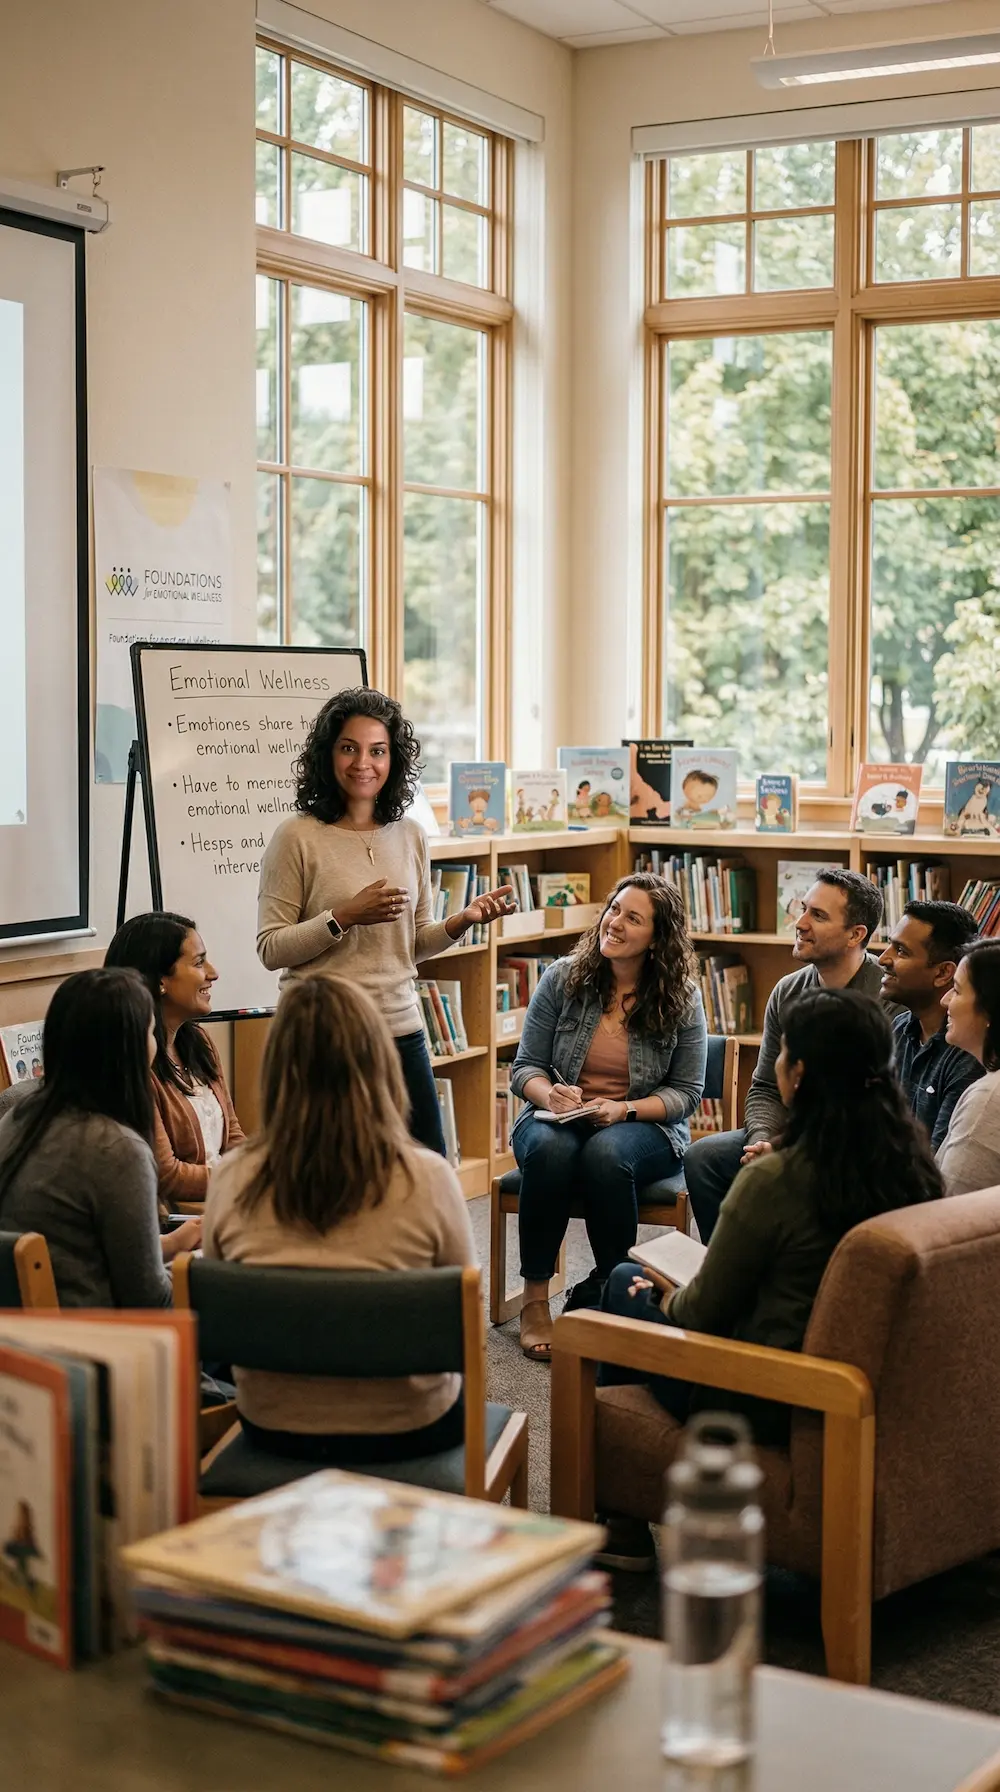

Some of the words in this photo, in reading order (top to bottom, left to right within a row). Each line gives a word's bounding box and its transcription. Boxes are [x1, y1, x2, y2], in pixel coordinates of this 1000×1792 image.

[144, 569, 223, 589] FOUNDATIONS
[153, 589, 190, 600] EMOTIONAL
[191, 592, 223, 602] WELLNESS
[169, 665, 250, 691] Emotional
[259, 669, 330, 691] Wellness
[176, 713, 250, 734] Emotiones
[258, 715, 294, 731] share
[196, 738, 261, 756] emotional
[267, 738, 307, 754] wellne
[182, 774, 218, 794] Have
[225, 774, 240, 791] to
[187, 798, 250, 817] emotional
[256, 796, 297, 814] wellne
[190, 832, 234, 856] Hesps
[240, 832, 266, 848] and
[213, 857, 263, 875] interve
